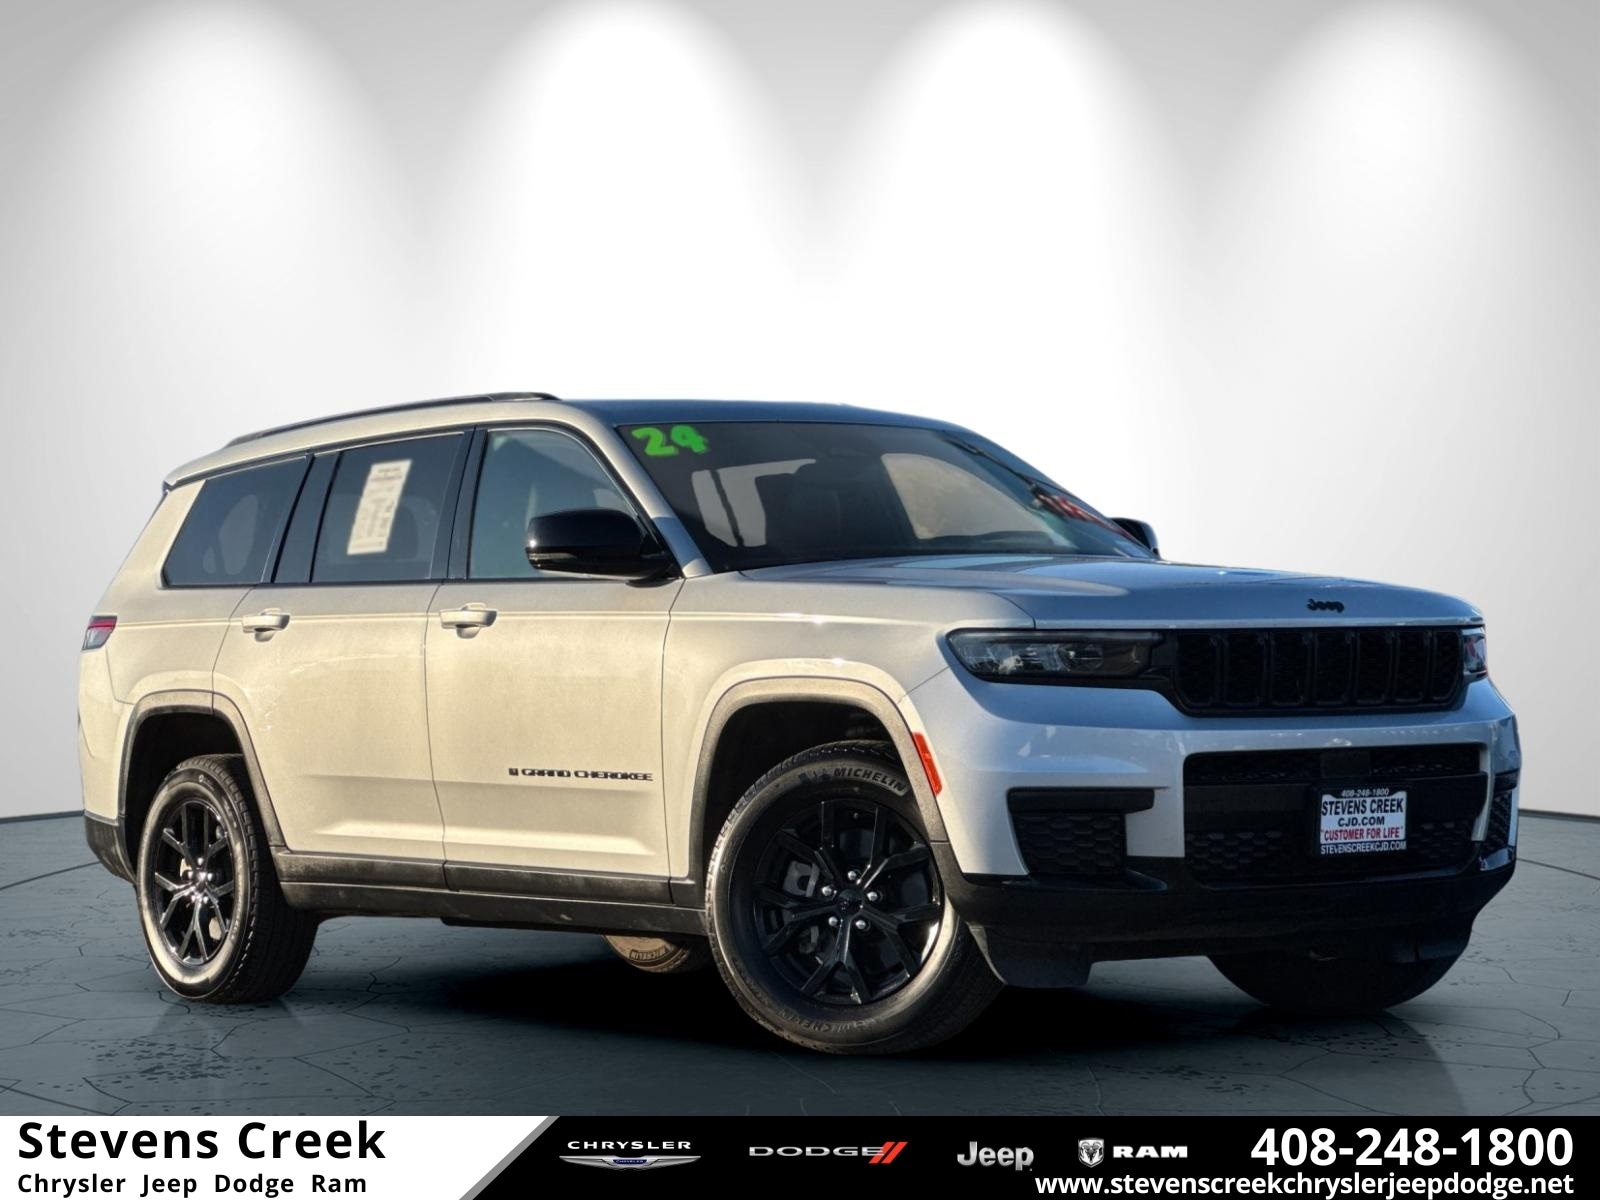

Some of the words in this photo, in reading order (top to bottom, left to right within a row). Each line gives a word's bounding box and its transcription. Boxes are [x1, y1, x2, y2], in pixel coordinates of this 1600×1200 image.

[631, 424, 709, 457] 24
[1306, 598, 1345, 613] Jeep
[521, 768, 571, 778] GRAND
[573, 770, 653, 781] CHEROKEE
[833, 767, 906, 792] MICHELIN
[1321, 800, 1367, 816] STEVENS
[1370, 798, 1404, 813] CREEK
[1337, 816, 1385, 827] CJD.COM
[1366, 828, 1381, 839] FOR
[1321, 841, 1406, 855] STEVENSCREEKCJD.COM
